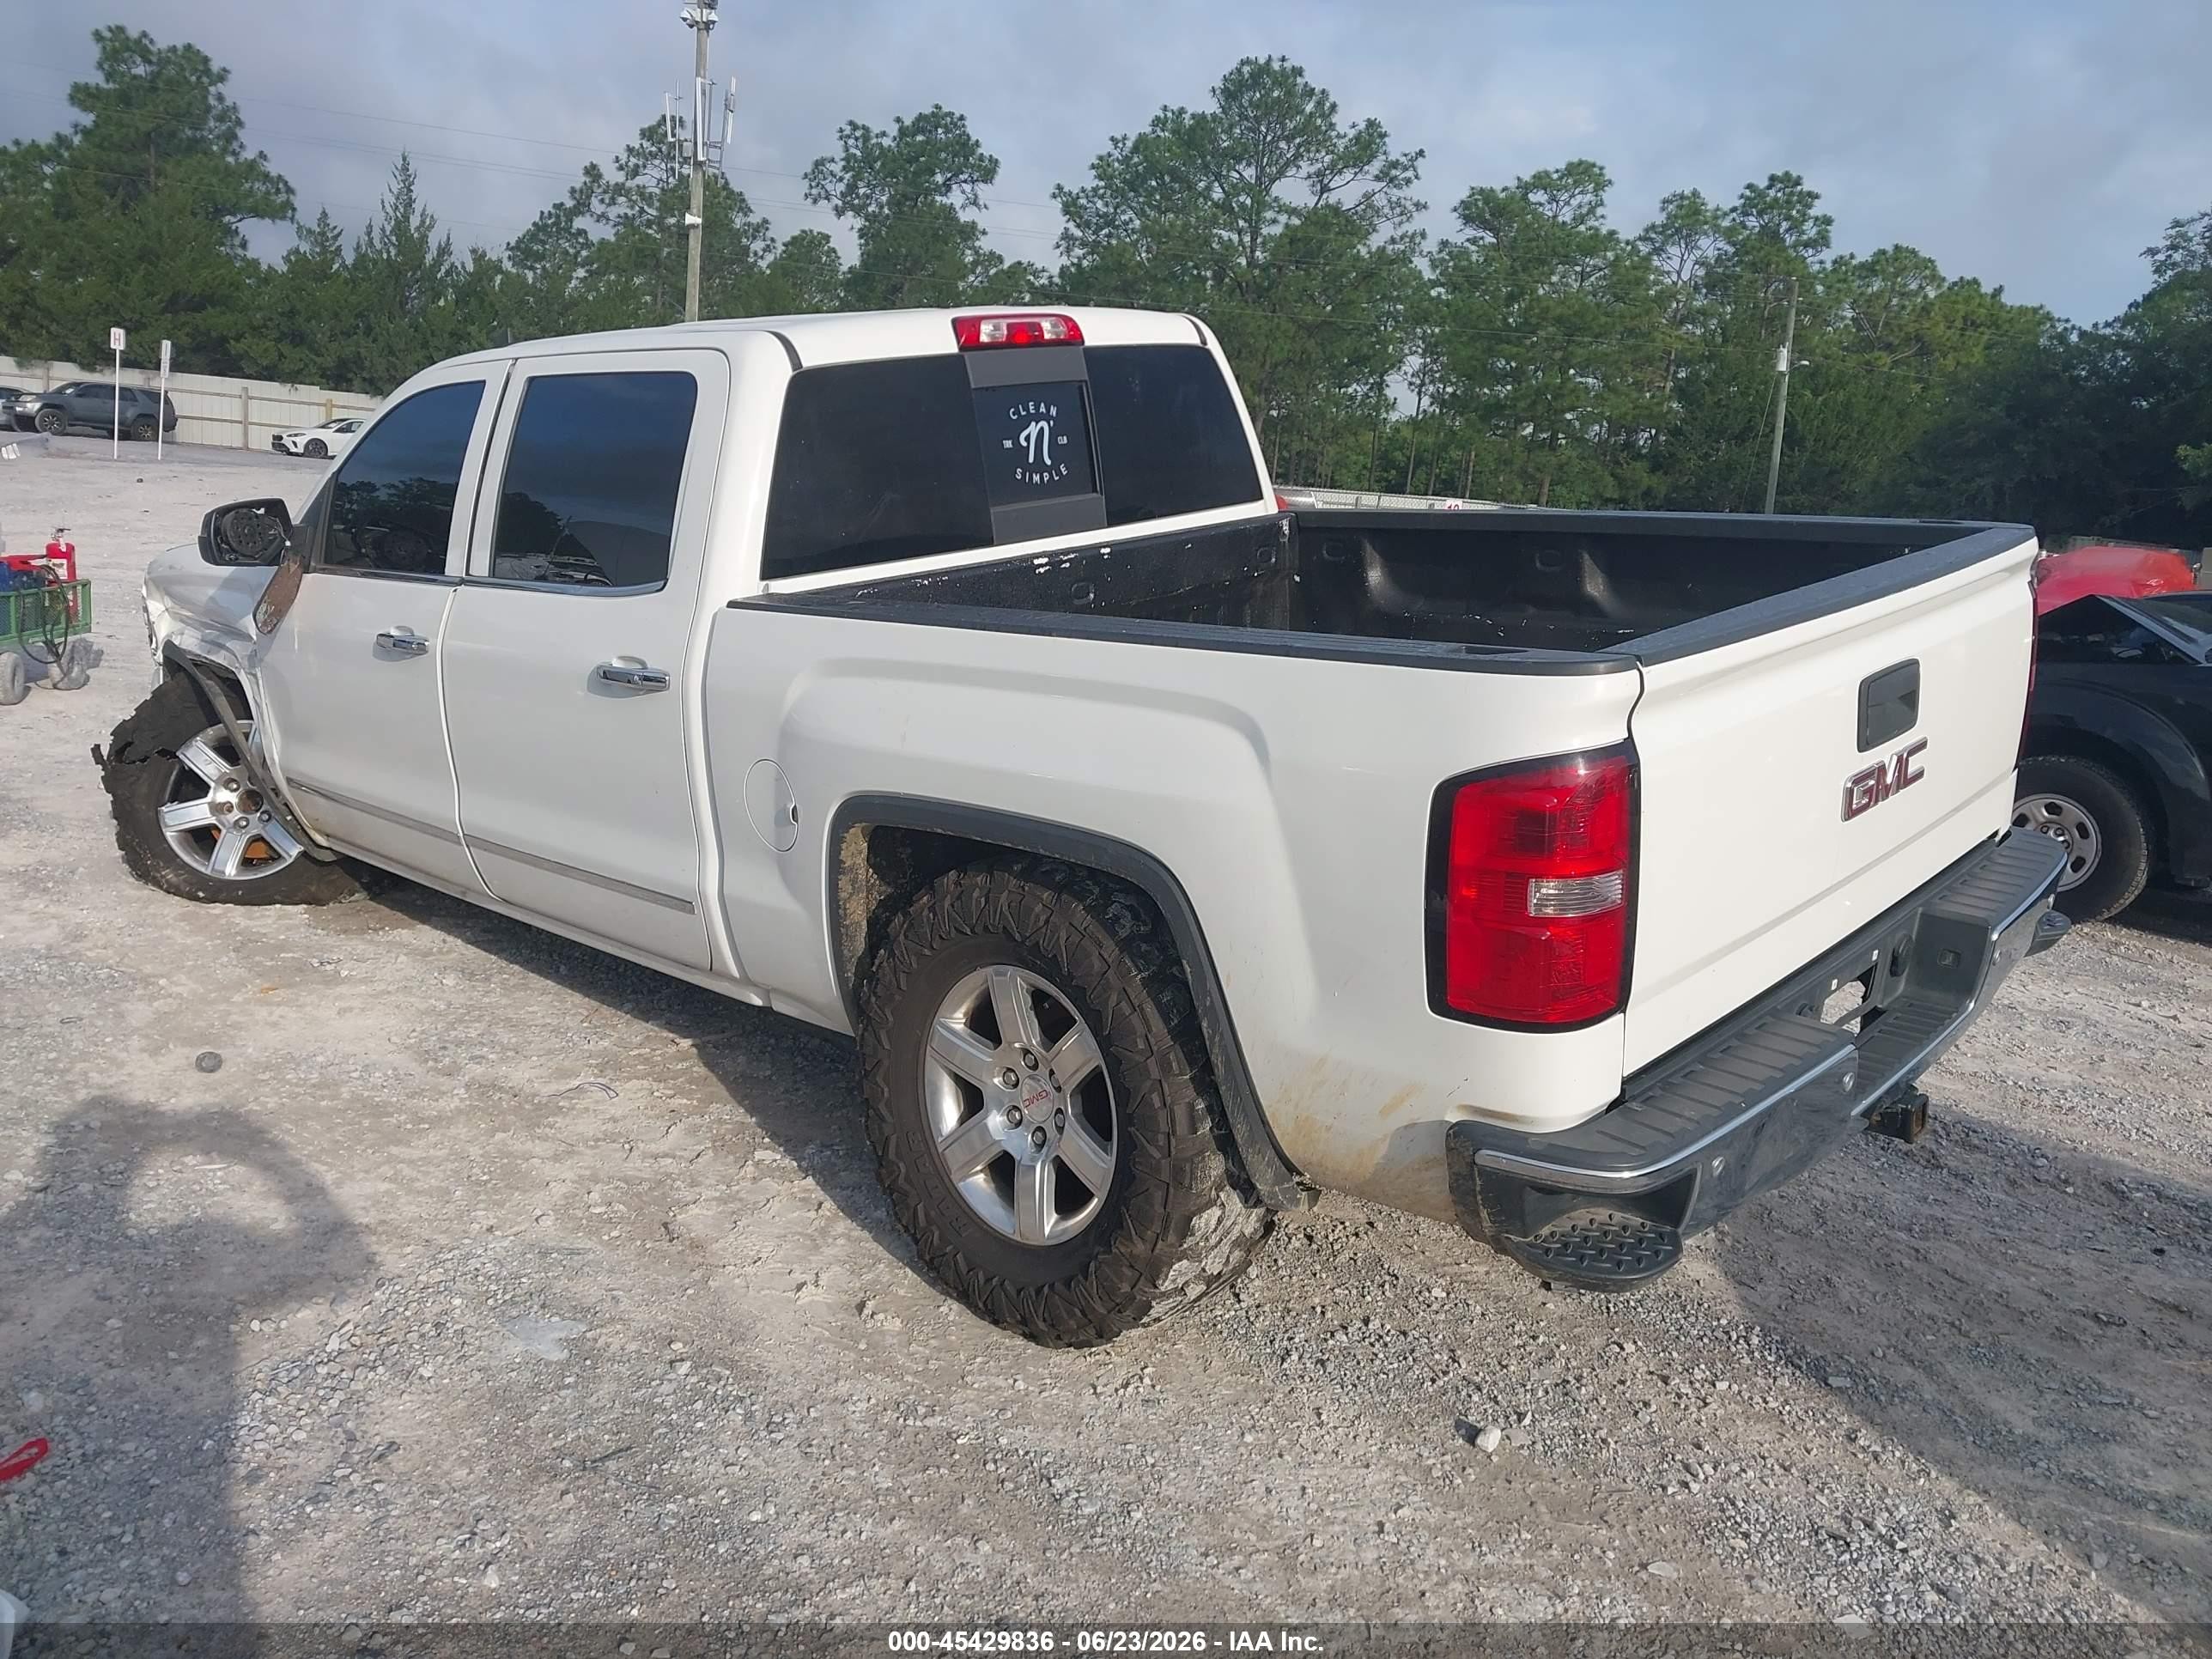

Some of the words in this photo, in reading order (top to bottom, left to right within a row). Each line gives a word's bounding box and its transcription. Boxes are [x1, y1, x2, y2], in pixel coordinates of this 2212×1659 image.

[113, 331, 121, 346] H
[1009, 401, 1058, 420] CLEAN
[1015, 463, 1068, 485] SIMPLE
[1841, 736, 1928, 823] GMC
[1023, 1089, 1048, 1109] GMC
